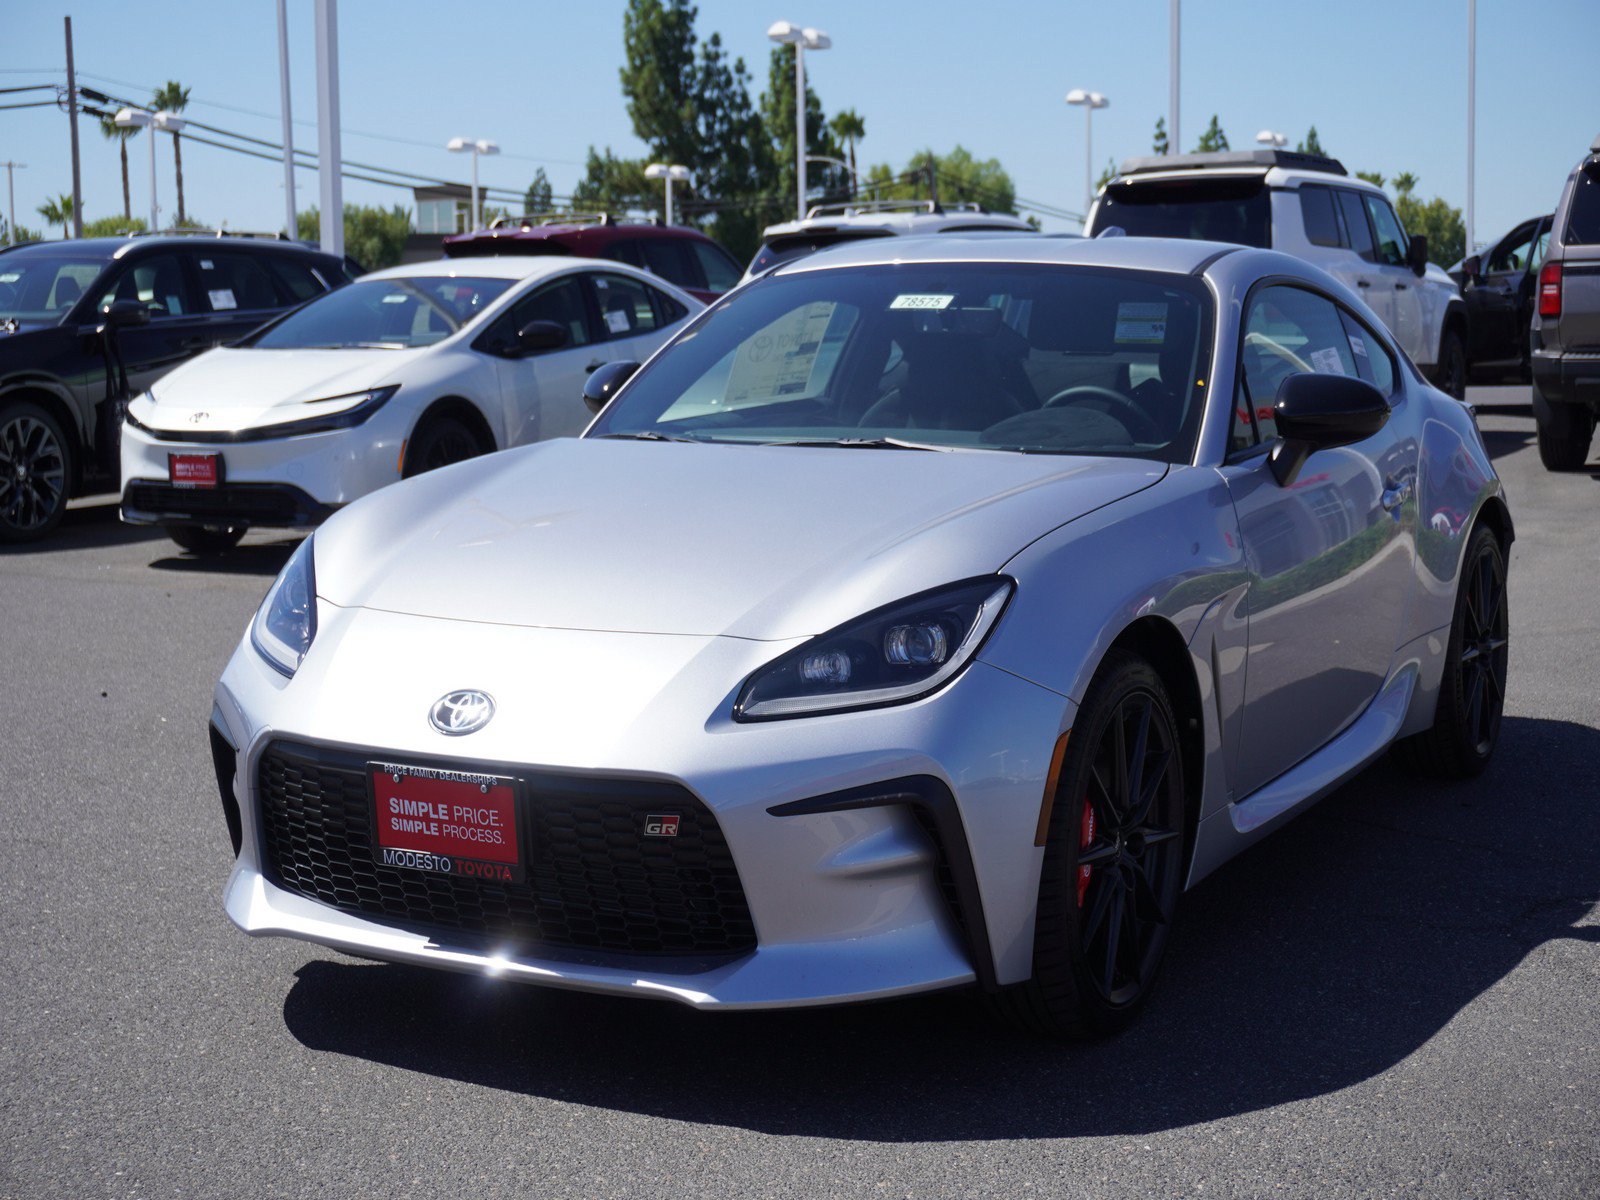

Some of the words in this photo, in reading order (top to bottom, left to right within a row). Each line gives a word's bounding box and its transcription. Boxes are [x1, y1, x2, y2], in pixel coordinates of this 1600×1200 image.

[900, 297, 943, 307] 78575
[384, 764, 407, 775] PRICE
[409, 768, 437, 779] FAMILY
[439, 772, 498, 786] DEALERSHIPS
[389, 797, 449, 820] SIMPLE
[453, 805, 504, 827] PRICE.
[390, 817, 439, 836] SIMPLE
[442, 824, 506, 845] PROCESS.
[646, 823, 677, 835] GR
[383, 849, 451, 873] MODESTO
[455, 859, 513, 881] TOYOTA
